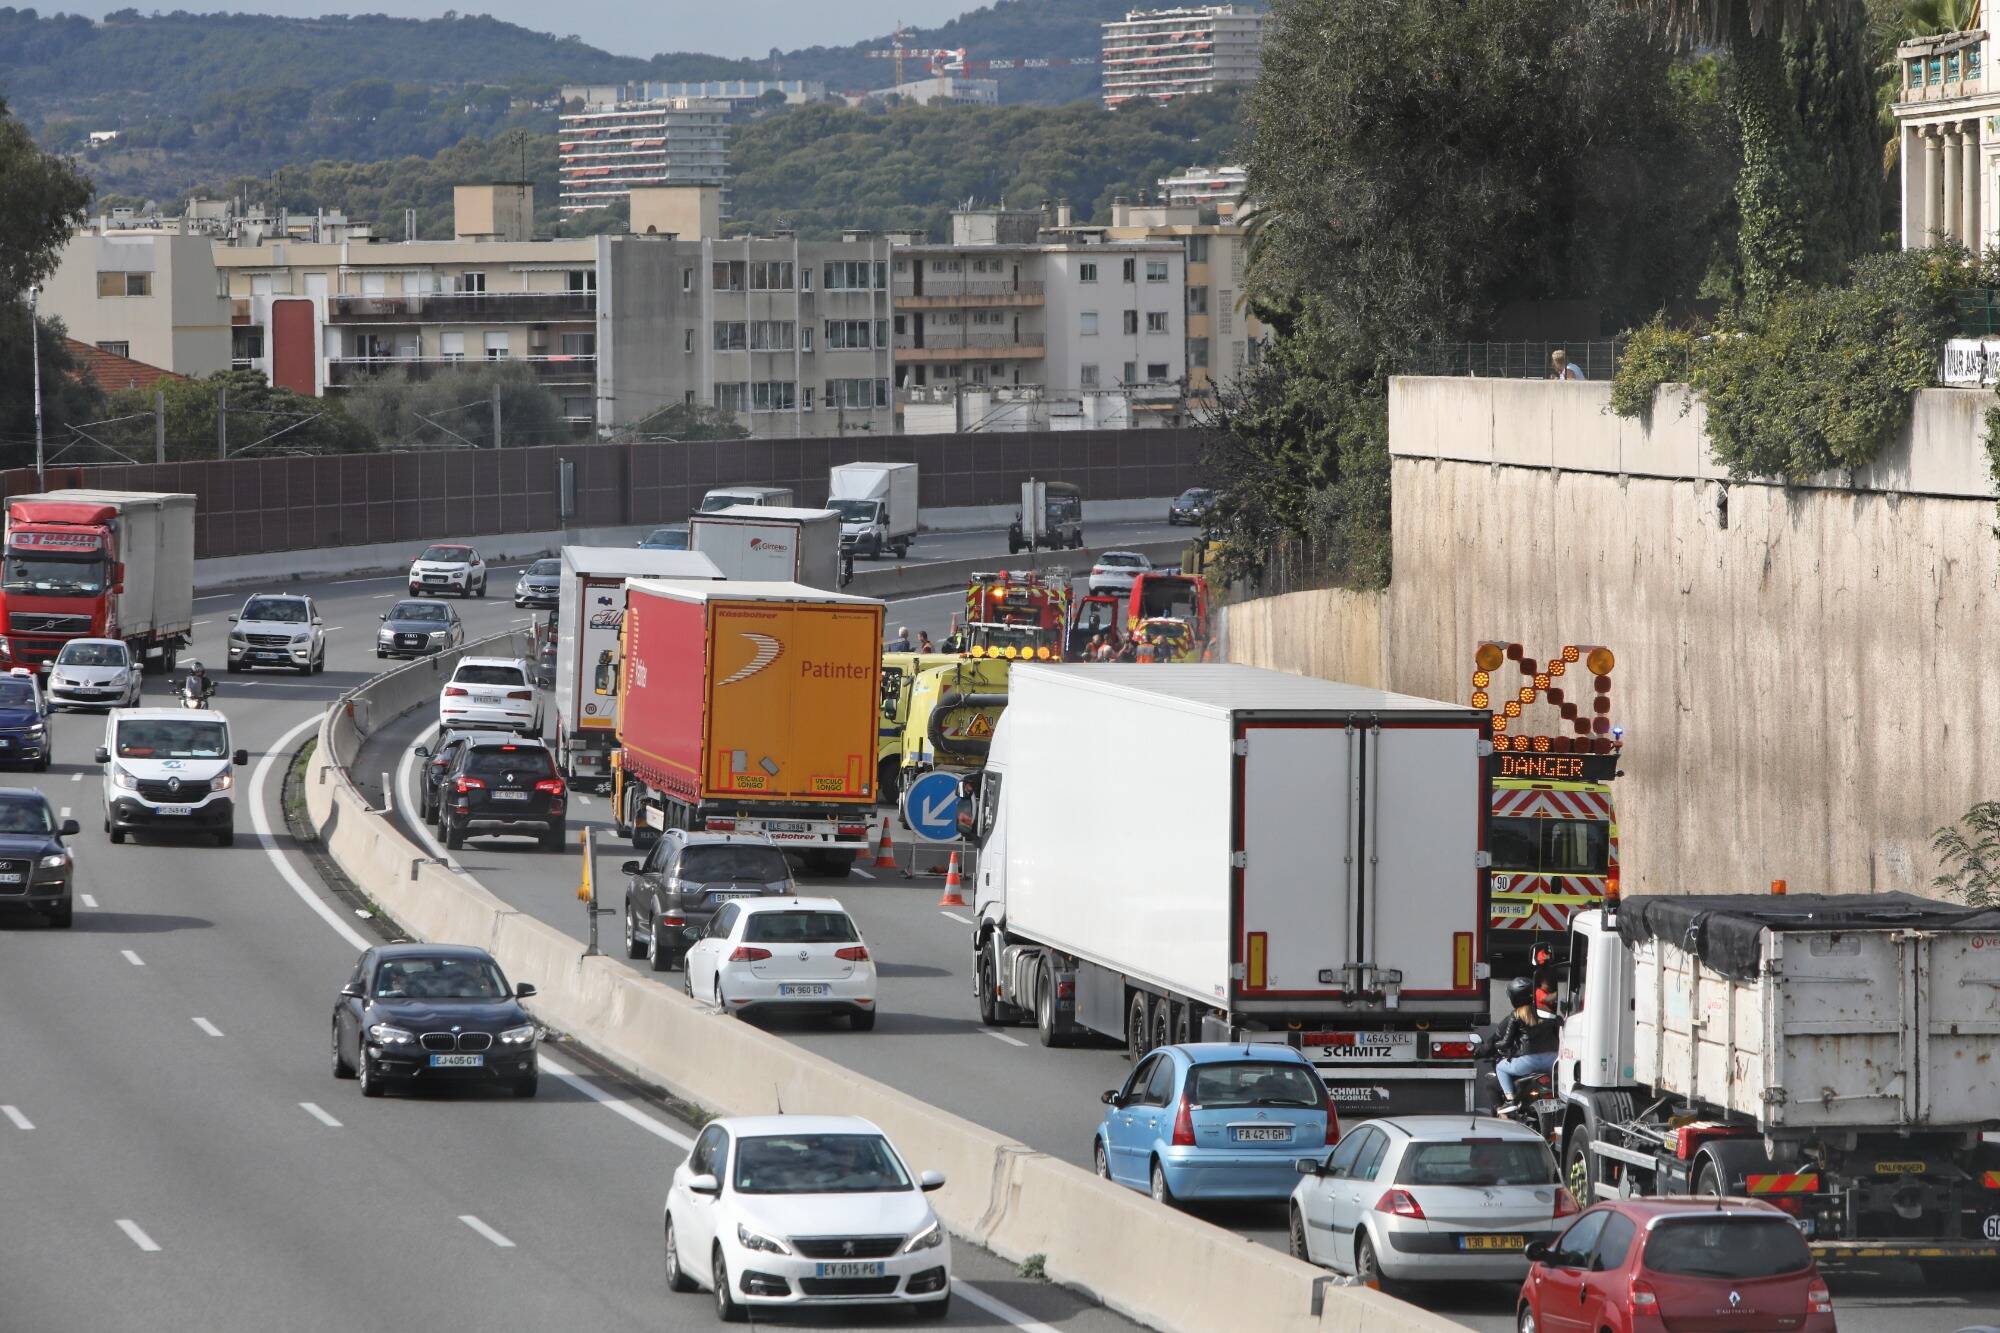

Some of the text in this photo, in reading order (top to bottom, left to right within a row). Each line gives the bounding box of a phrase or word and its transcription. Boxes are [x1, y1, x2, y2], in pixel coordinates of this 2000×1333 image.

[802, 660, 871, 679] Patinter
[1502, 756, 1583, 777] DANGER
[1497, 876, 1507, 889] 90
[1366, 1033, 1410, 1044] 4645 KFL
[1323, 1046, 1392, 1057] SCHMITZ
